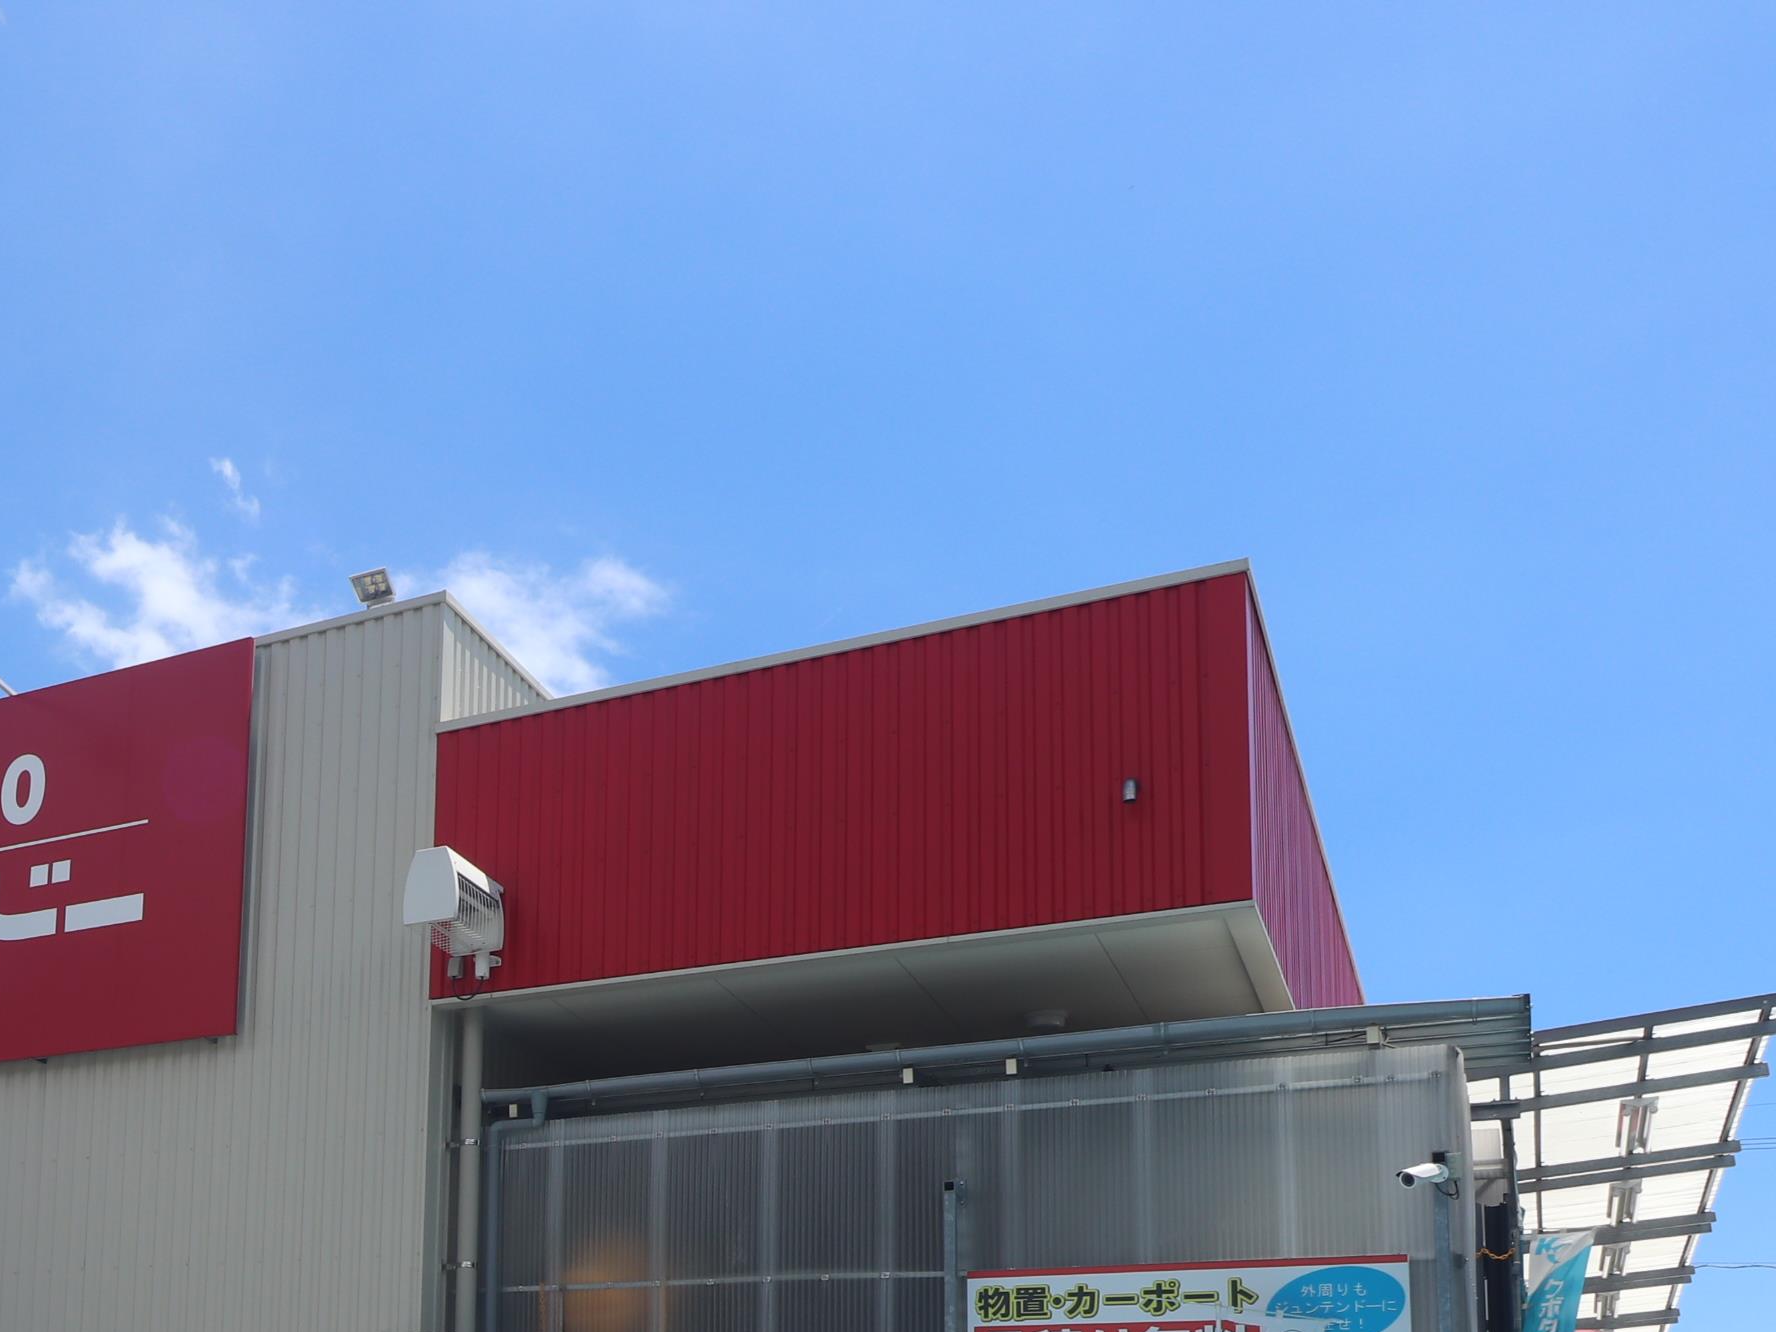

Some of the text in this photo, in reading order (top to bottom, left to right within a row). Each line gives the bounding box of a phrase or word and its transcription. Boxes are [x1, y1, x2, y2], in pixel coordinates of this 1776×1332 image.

[978, 1277, 1259, 1320] 物置・カーポート
[1300, 1282, 1367, 1297] 外周りも
